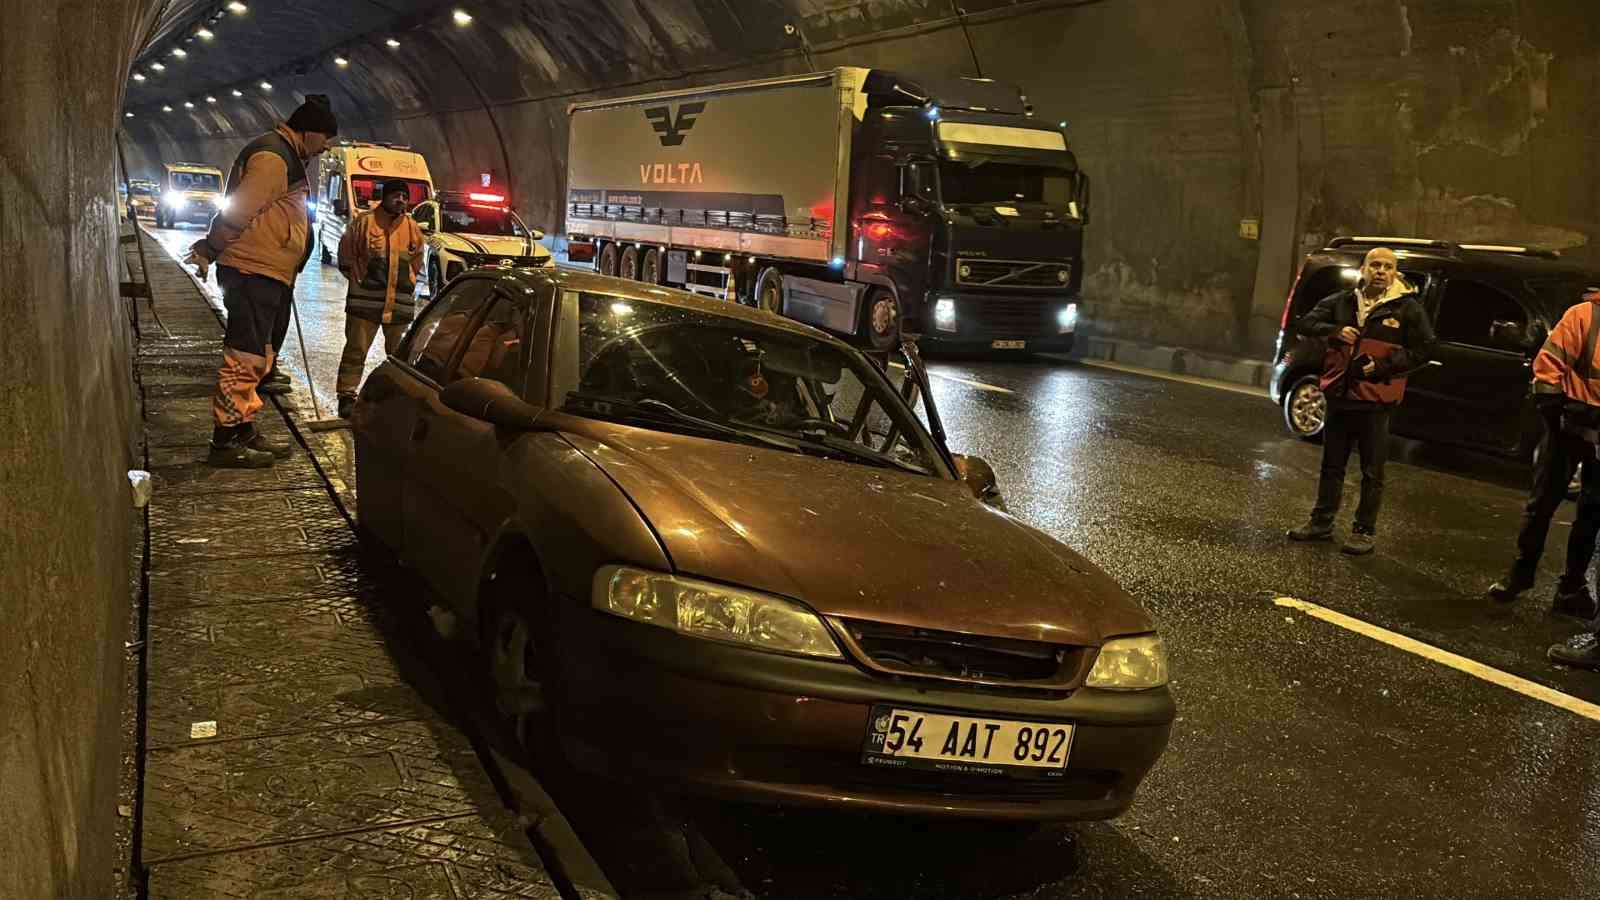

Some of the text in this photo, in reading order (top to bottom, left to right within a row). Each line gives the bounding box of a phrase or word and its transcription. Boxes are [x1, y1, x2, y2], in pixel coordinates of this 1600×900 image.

[640, 162, 704, 185] VOLTA
[871, 732, 885, 745] TR
[886, 714, 1066, 764] 54 AAT 892
